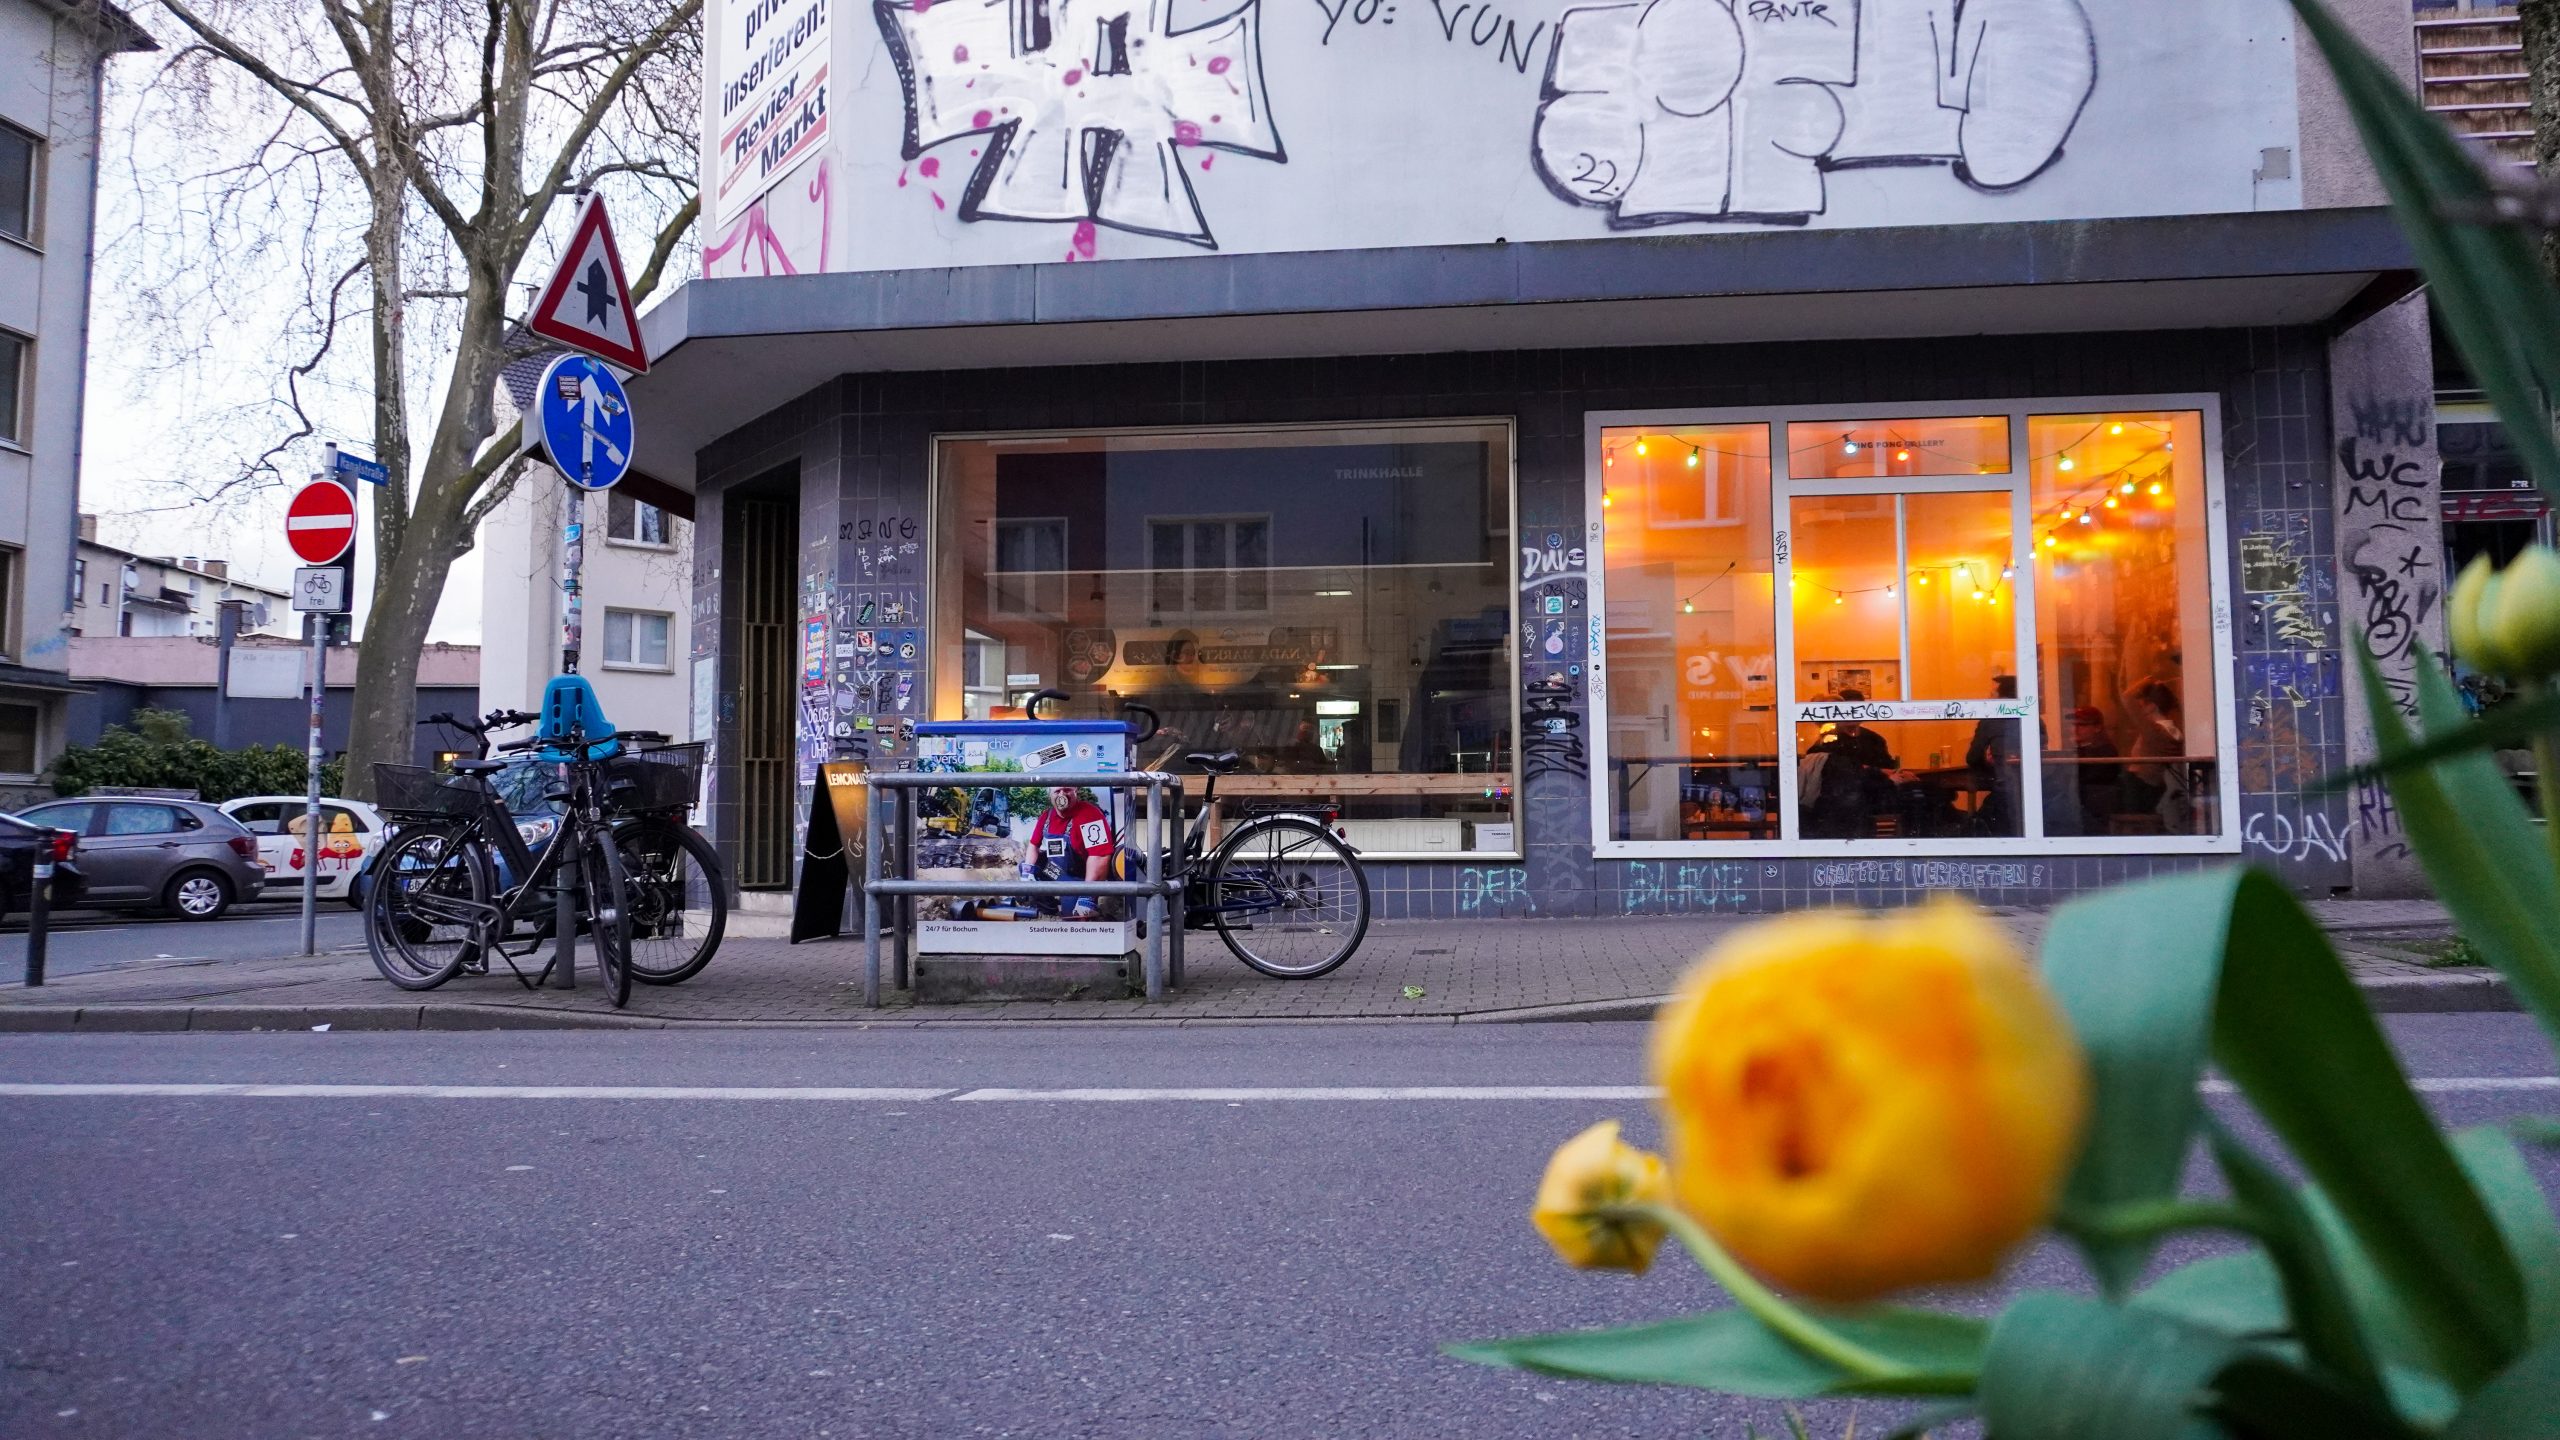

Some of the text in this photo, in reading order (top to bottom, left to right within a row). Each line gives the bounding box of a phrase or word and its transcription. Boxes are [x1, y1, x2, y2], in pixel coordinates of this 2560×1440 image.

[724, 0, 826, 117] inserieren!
[735, 72, 799, 166] Revier
[760, 85, 827, 180] Markt
[1876, 440, 1902, 449] PONG
[1335, 466, 1425, 480] TRINKHALLE
[309, 597, 325, 606] frei
[811, 742, 829, 759] UHR
[925, 925, 940, 933] 24/7
[952, 925, 978, 933] Bochum
